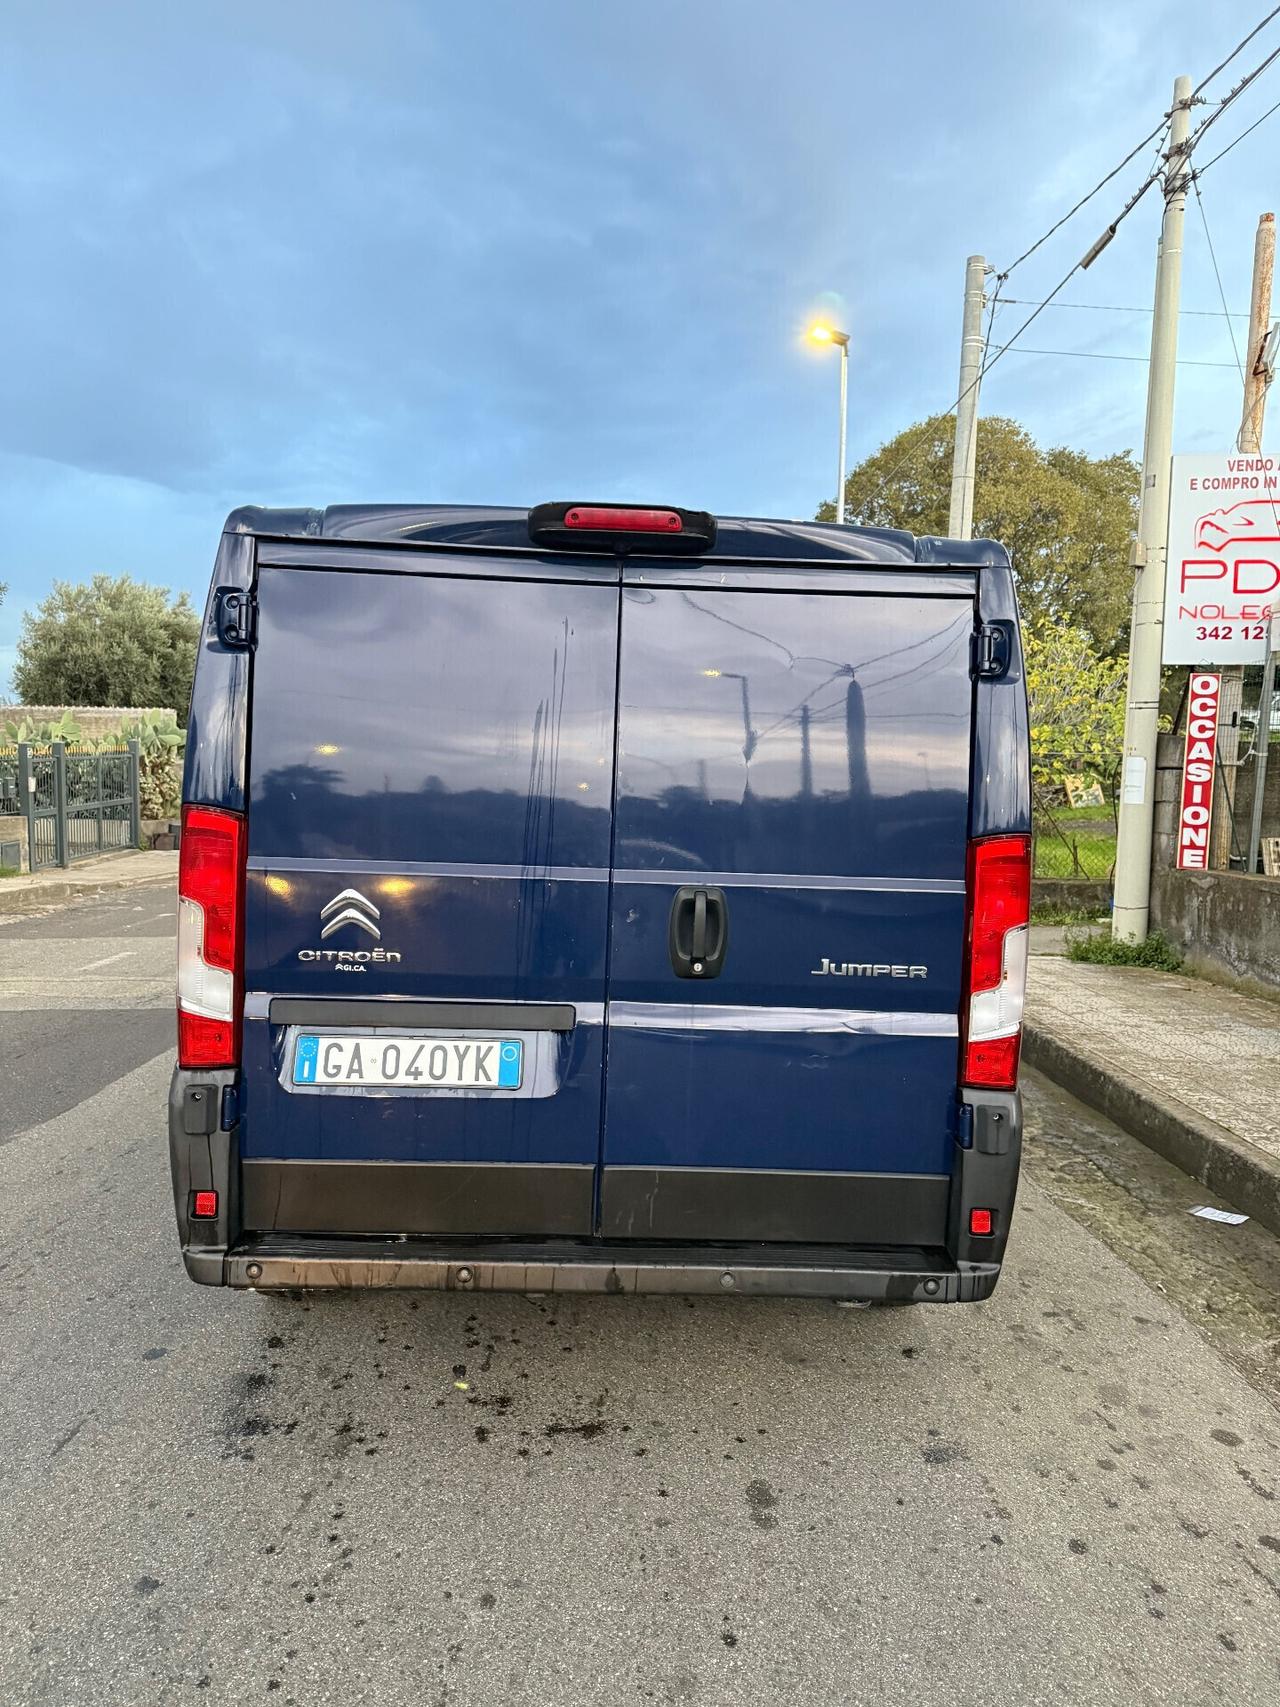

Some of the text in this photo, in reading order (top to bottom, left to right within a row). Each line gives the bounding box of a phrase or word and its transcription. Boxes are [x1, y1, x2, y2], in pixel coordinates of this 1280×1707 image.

[1228, 459, 1273, 472] VENDO
[1190, 478, 1198, 491] E
[1202, 476, 1259, 491] COMPRO
[1196, 626, 1269, 641] 342 12
[1181, 675, 1219, 868] OCCASIONE
[323, 1042, 364, 1080] GA
[381, 1044, 495, 1083] 040YK
